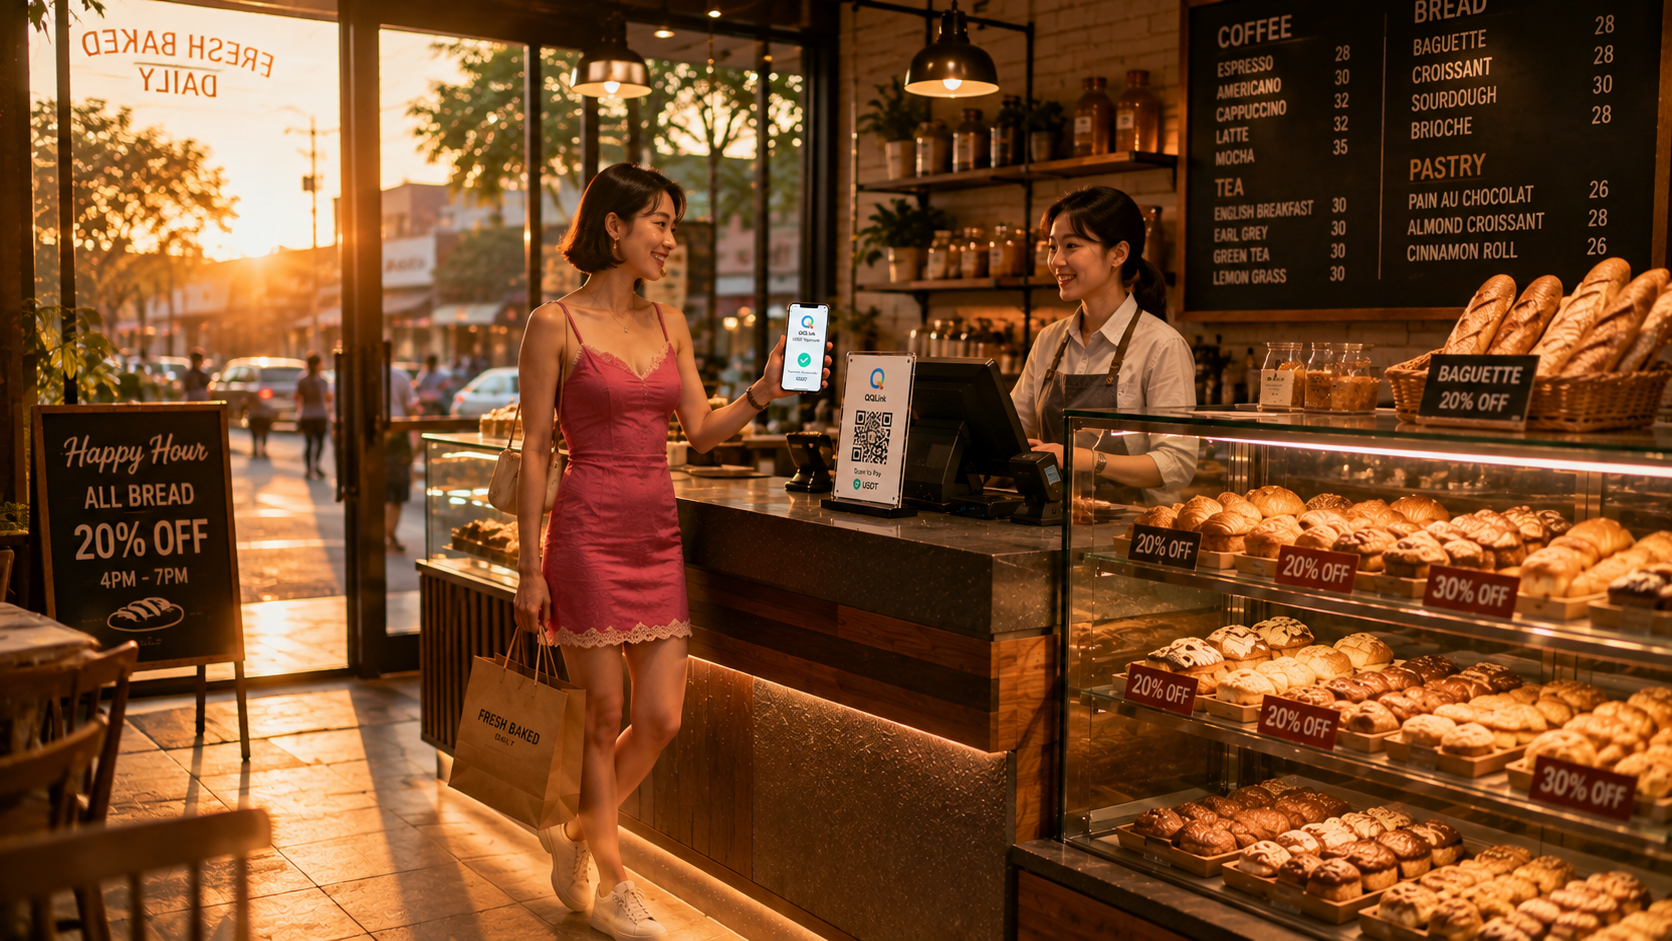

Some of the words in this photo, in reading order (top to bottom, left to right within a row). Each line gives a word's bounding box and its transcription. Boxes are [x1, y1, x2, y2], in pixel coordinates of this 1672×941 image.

[1415, 0, 1486, 23] BREAD
[1218, 15, 1293, 48] COFFEE
[1414, 29, 1487, 57] BAGUETTE
[1595, 15, 1614, 35] 28
[1218, 55, 1275, 78] ESPRESSO
[1335, 45, 1350, 61] 28
[1413, 57, 1492, 83] CROISSANT
[1594, 45, 1613, 64] 28
[1217, 76, 1282, 100] AMERICANO
[1335, 69, 1349, 85] 30
[1412, 86, 1496, 111] SOURDOUGH
[1593, 75, 1612, 94] 30
[1217, 99, 1286, 122] CAPPUCCINO
[1334, 92, 1349, 108] 32
[1216, 127, 1249, 144] LATTE
[1334, 116, 1348, 131] 32
[1411, 117, 1472, 139] BRIOCHE
[1592, 105, 1611, 124] 28
[1216, 148, 1255, 165] MOCHA
[1333, 139, 1348, 155] 35
[1410, 153, 1486, 181] PASTRY
[1215, 178, 1244, 197] TEA
[1409, 192, 1437, 209] PAIN
[1441, 191, 1458, 207] AU
[1463, 185, 1534, 206] CHOCOLAT
[1589, 180, 1608, 198] 26
[1214, 205, 1254, 221] ENGLISH
[1257, 200, 1314, 218] BREAKFAST
[1332, 197, 1346, 213] 30
[1408, 217, 1462, 235] ALMOND
[1467, 212, 1545, 232] CROISSANT
[1588, 209, 1607, 226] 28
[1214, 228, 1239, 242] EARL
[1242, 226, 1268, 241] GREY
[1331, 220, 1346, 236] 30
[1214, 249, 1247, 264] GREEN
[1250, 247, 1269, 261] TEA
[1331, 243, 1345, 258] 30
[1407, 243, 1478, 261] CINNAMON
[1484, 242, 1517, 259] ROLL
[1587, 237, 1606, 255] 26
[1213, 270, 1249, 285] LEMON
[1250, 268, 1286, 284] GRASS
[1330, 266, 1345, 281] 30
[1438, 365, 1523, 384] BAGUETTE
[864, 393, 888, 403] QQLink
[1439, 391, 1473, 410] 20%
[1478, 393, 1509, 412] OFF
[64, 435, 144, 475] Happy
[150, 433, 208, 464] Hour
[85, 486, 122, 509] ALL
[129, 483, 194, 506] BREAD
[74, 521, 145, 560] 20%
[154, 519, 208, 555] OFF
[1134, 529, 1166, 556] 20%
[1164, 537, 1195, 561] OFF
[100, 571, 136, 588] 4PM
[154, 567, 188, 585] 7PM
[1281, 551, 1316, 579] 20%
[1314, 559, 1350, 583] OFF
[1432, 573, 1473, 602] 30%
[1478, 584, 1509, 607] OFF
[1132, 674, 1163, 699] 20%
[1163, 681, 1193, 707] OFF
[478, 709, 508, 731] FRESH
[508, 722, 540, 746] BAKED
[1264, 702, 1299, 731] 20%
[1299, 712, 1331, 738] OFF
[1539, 769, 1585, 803] 30%
[1586, 780, 1626, 812] OFF
